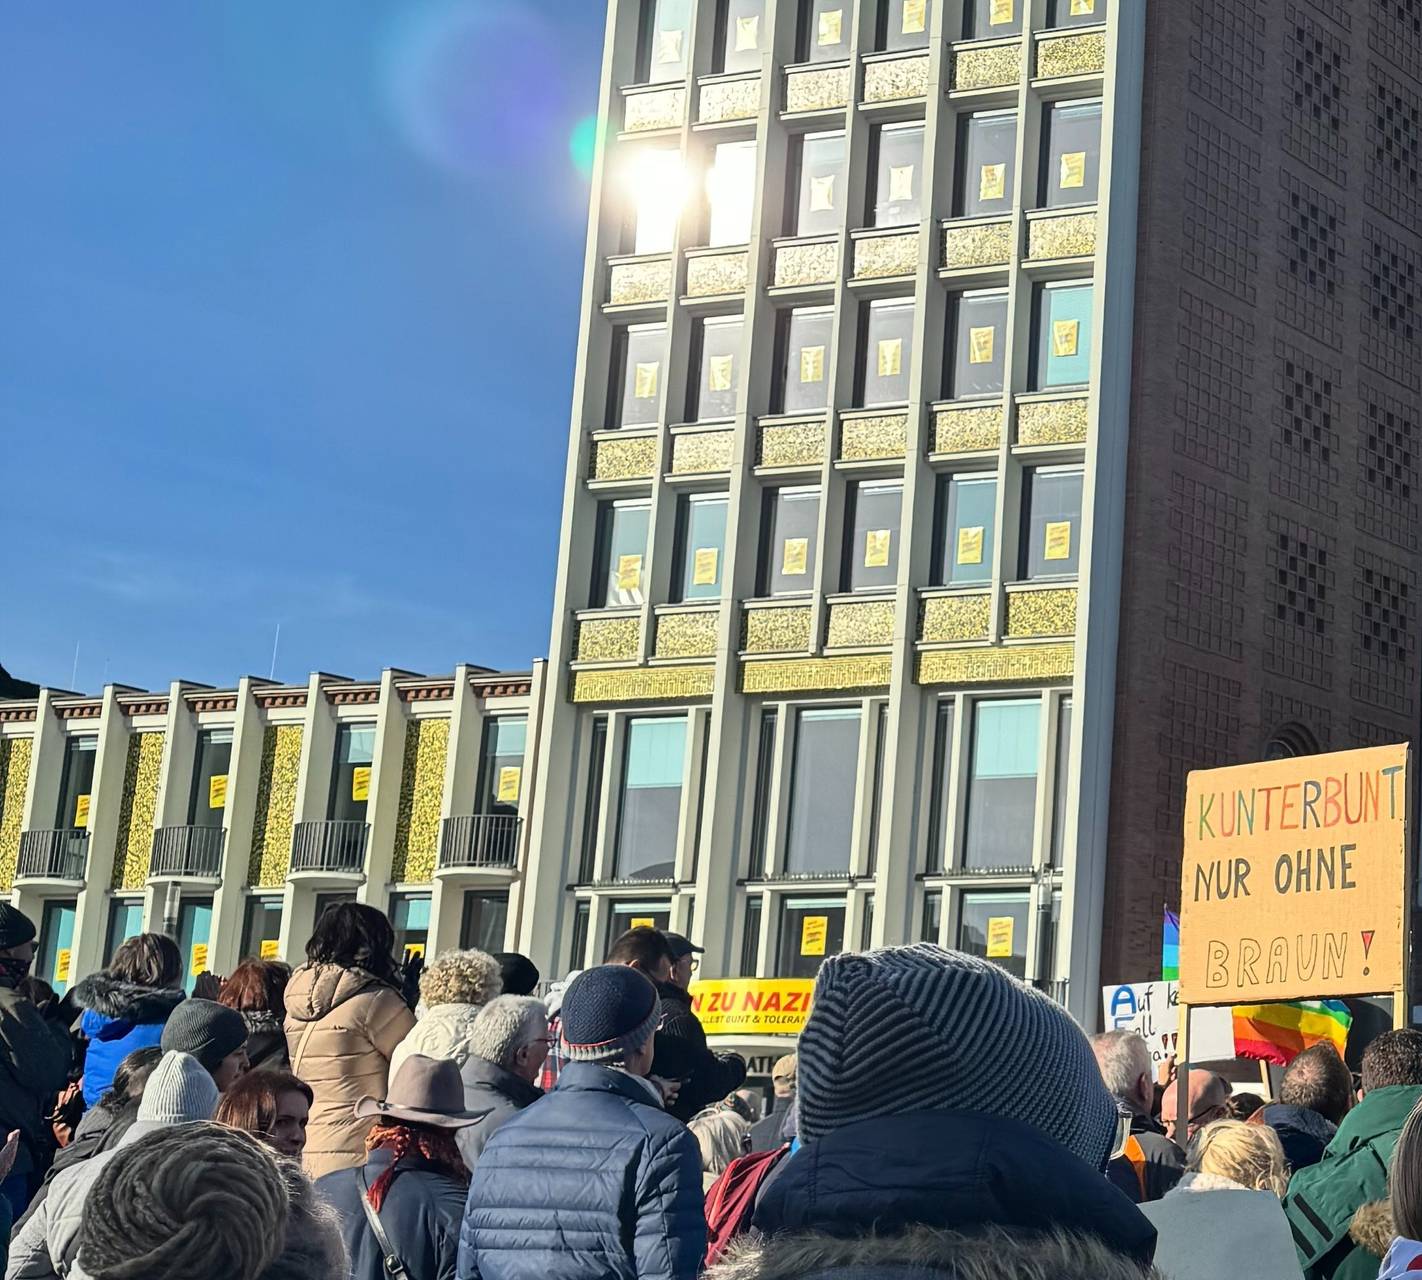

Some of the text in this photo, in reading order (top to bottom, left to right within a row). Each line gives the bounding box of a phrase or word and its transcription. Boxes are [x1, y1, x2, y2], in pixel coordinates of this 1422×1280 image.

[1199, 765, 1404, 841] KUNTERBUNT
[1194, 843, 1357, 902] NUR OHNE
[707, 992, 736, 1012] ZU
[1110, 984, 1153, 1016] Auf
[725, 1014, 751, 1024] BUNT
[751, 1015, 760, 1024] &
